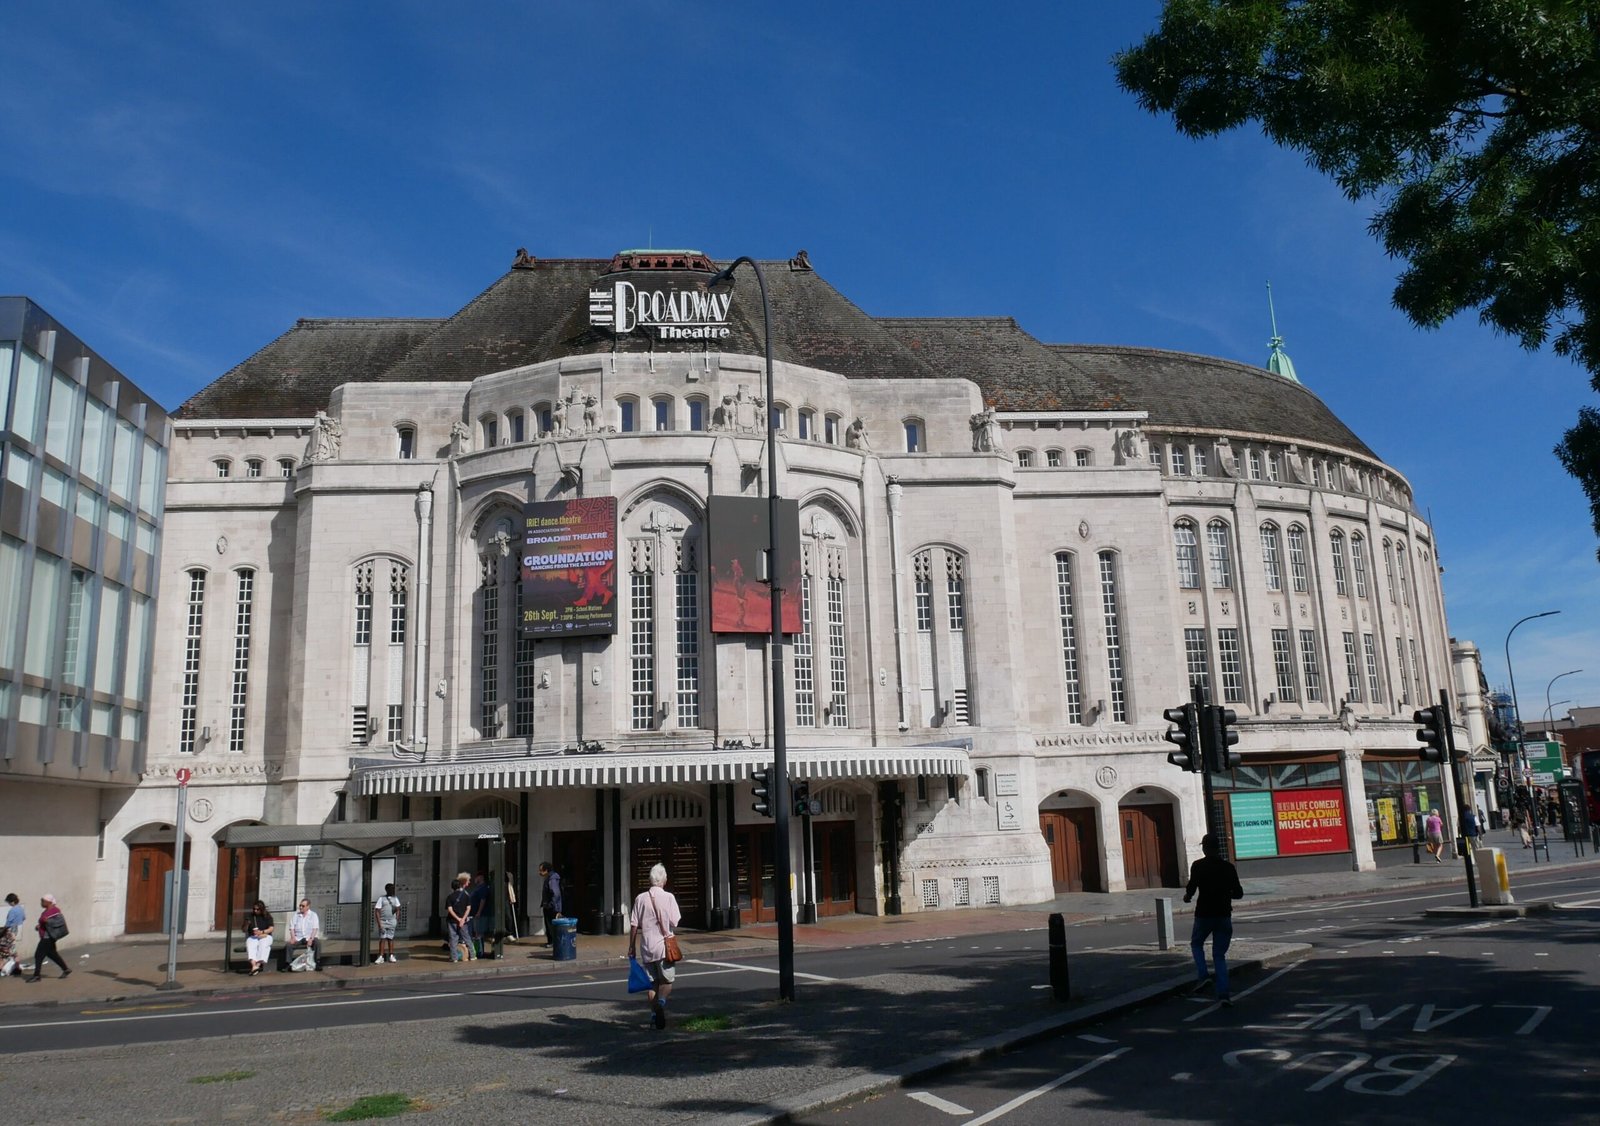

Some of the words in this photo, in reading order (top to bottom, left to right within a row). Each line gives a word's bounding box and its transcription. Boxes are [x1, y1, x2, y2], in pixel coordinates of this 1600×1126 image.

[589, 288, 614, 326] THE
[615, 281, 733, 333] BROADWAY
[658, 325, 731, 339] Theatre
[526, 518, 540, 528] IRIE!
[541, 517, 558, 527] dance
[559, 515, 582, 525] theatre
[572, 531, 608, 541] THEATRE
[523, 550, 614, 567] GROUNDATION
[523, 610, 540, 622] 26th
[541, 609, 559, 622] Sept.
[178, 769, 185, 781] J
[1309, 799, 1340, 810] COMEDY
[1277, 809, 1340, 821] BROADWAY
[1278, 819, 1311, 830] MUSIC
[1312, 819, 1319, 828] &
[1319, 817, 1342, 828] THEATRE
[1242, 1003, 1552, 1035] LANE
